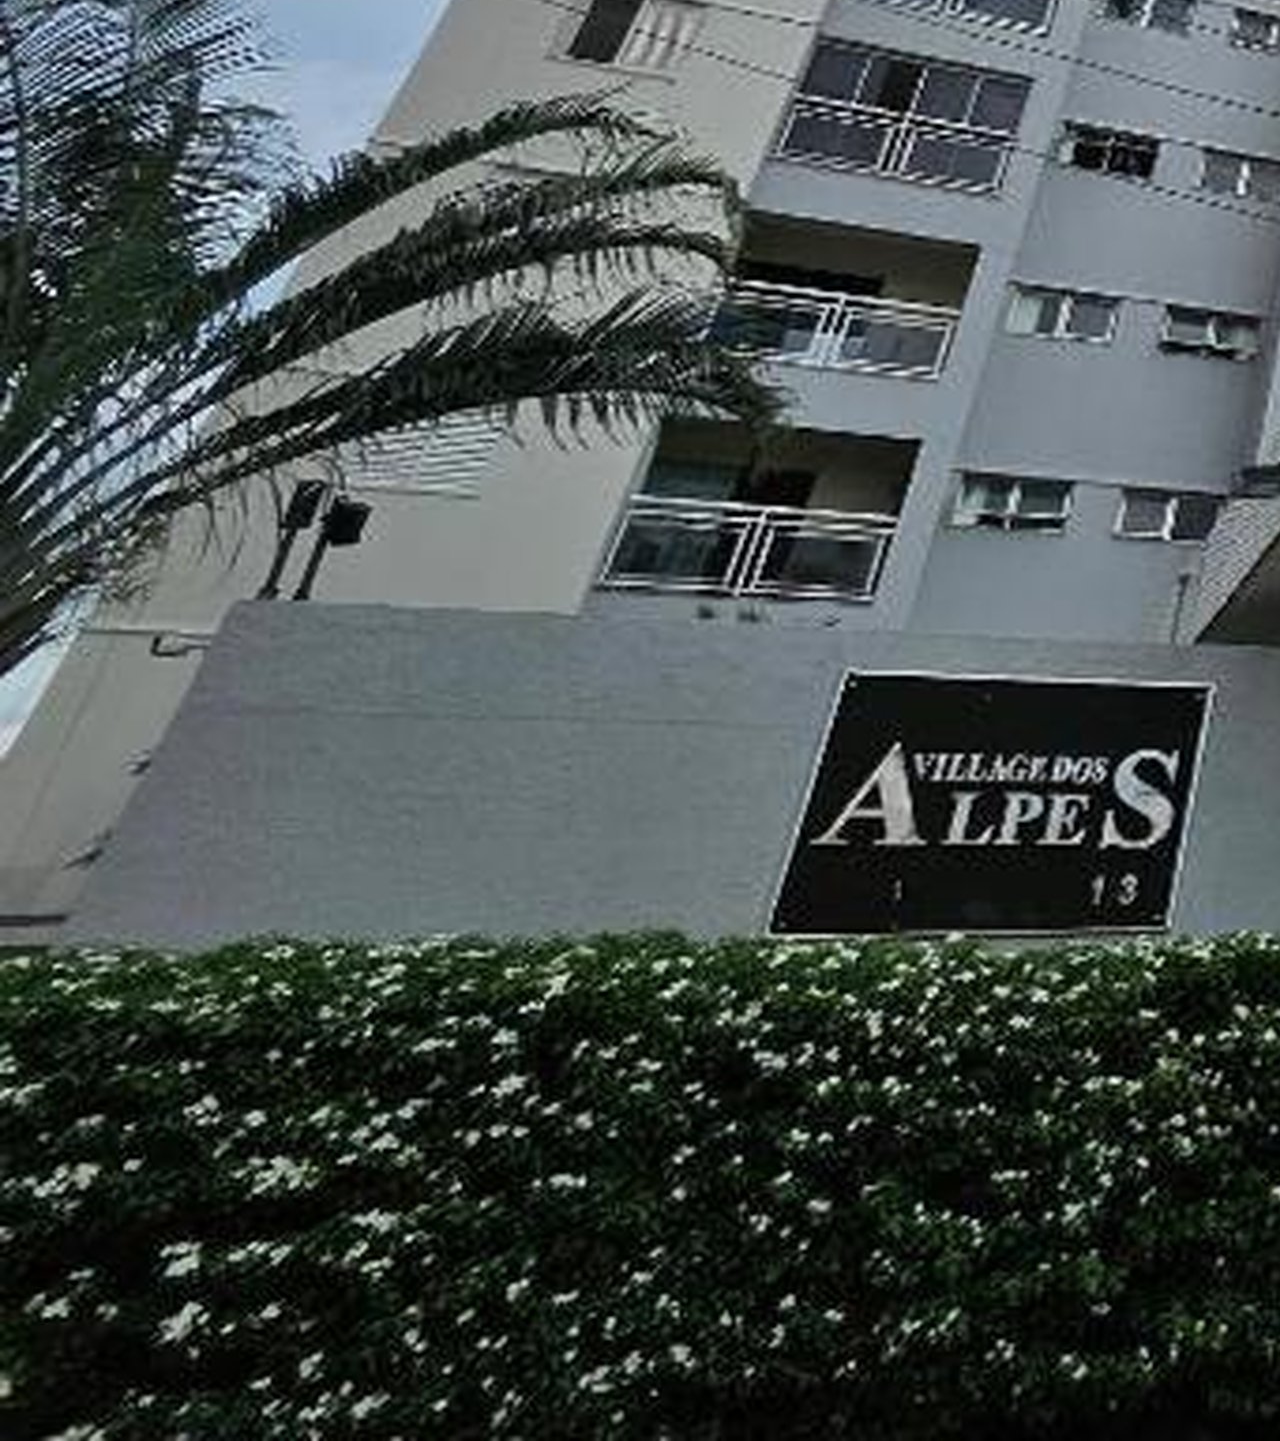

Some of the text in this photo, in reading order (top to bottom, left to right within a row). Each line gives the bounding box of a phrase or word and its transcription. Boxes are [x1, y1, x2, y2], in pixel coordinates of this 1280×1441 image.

[809, 741, 1180, 850] ALPES
[912, 752, 1110, 785] VILLAGE DOS
